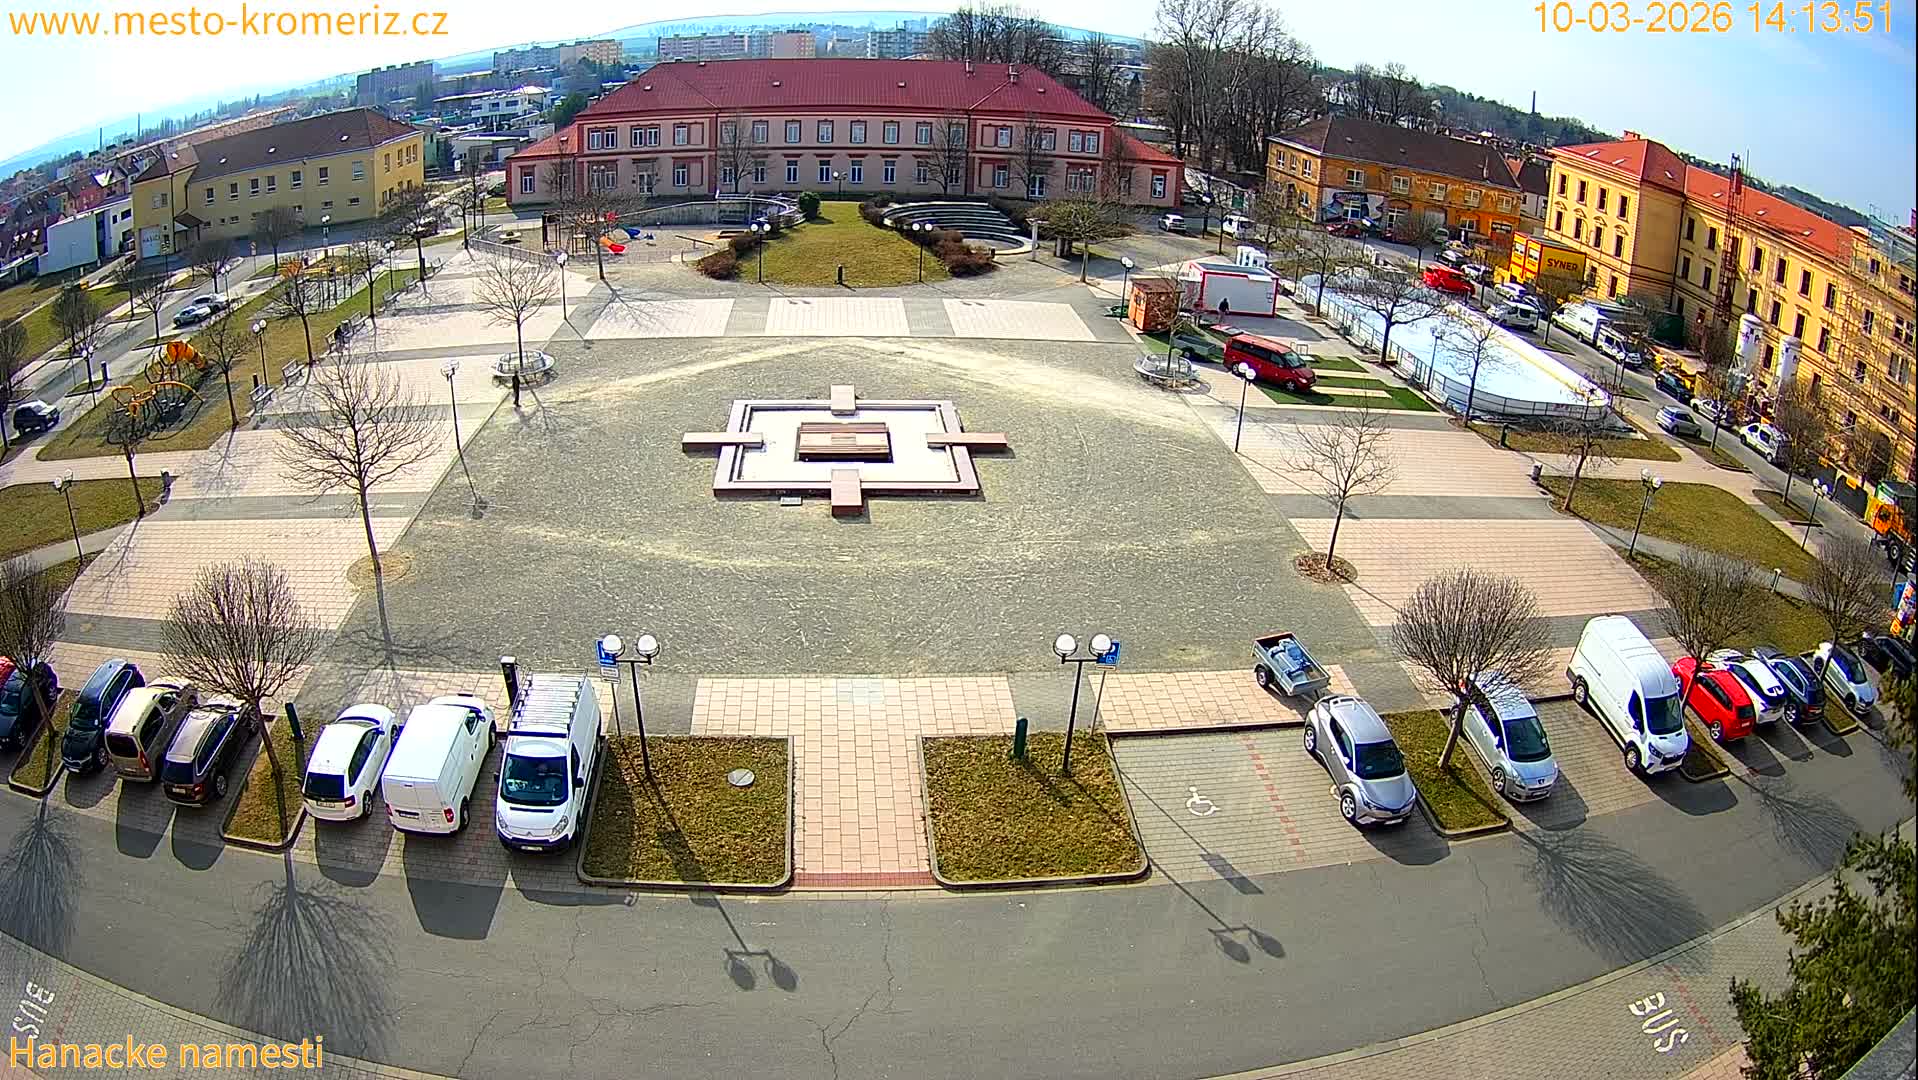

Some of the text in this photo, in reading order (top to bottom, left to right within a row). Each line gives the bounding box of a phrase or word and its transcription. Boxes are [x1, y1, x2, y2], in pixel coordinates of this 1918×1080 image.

[1547, 258, 1578, 272] SYNER
[12, 981, 55, 1040] BUS
[1628, 992, 1689, 1052] BUS
